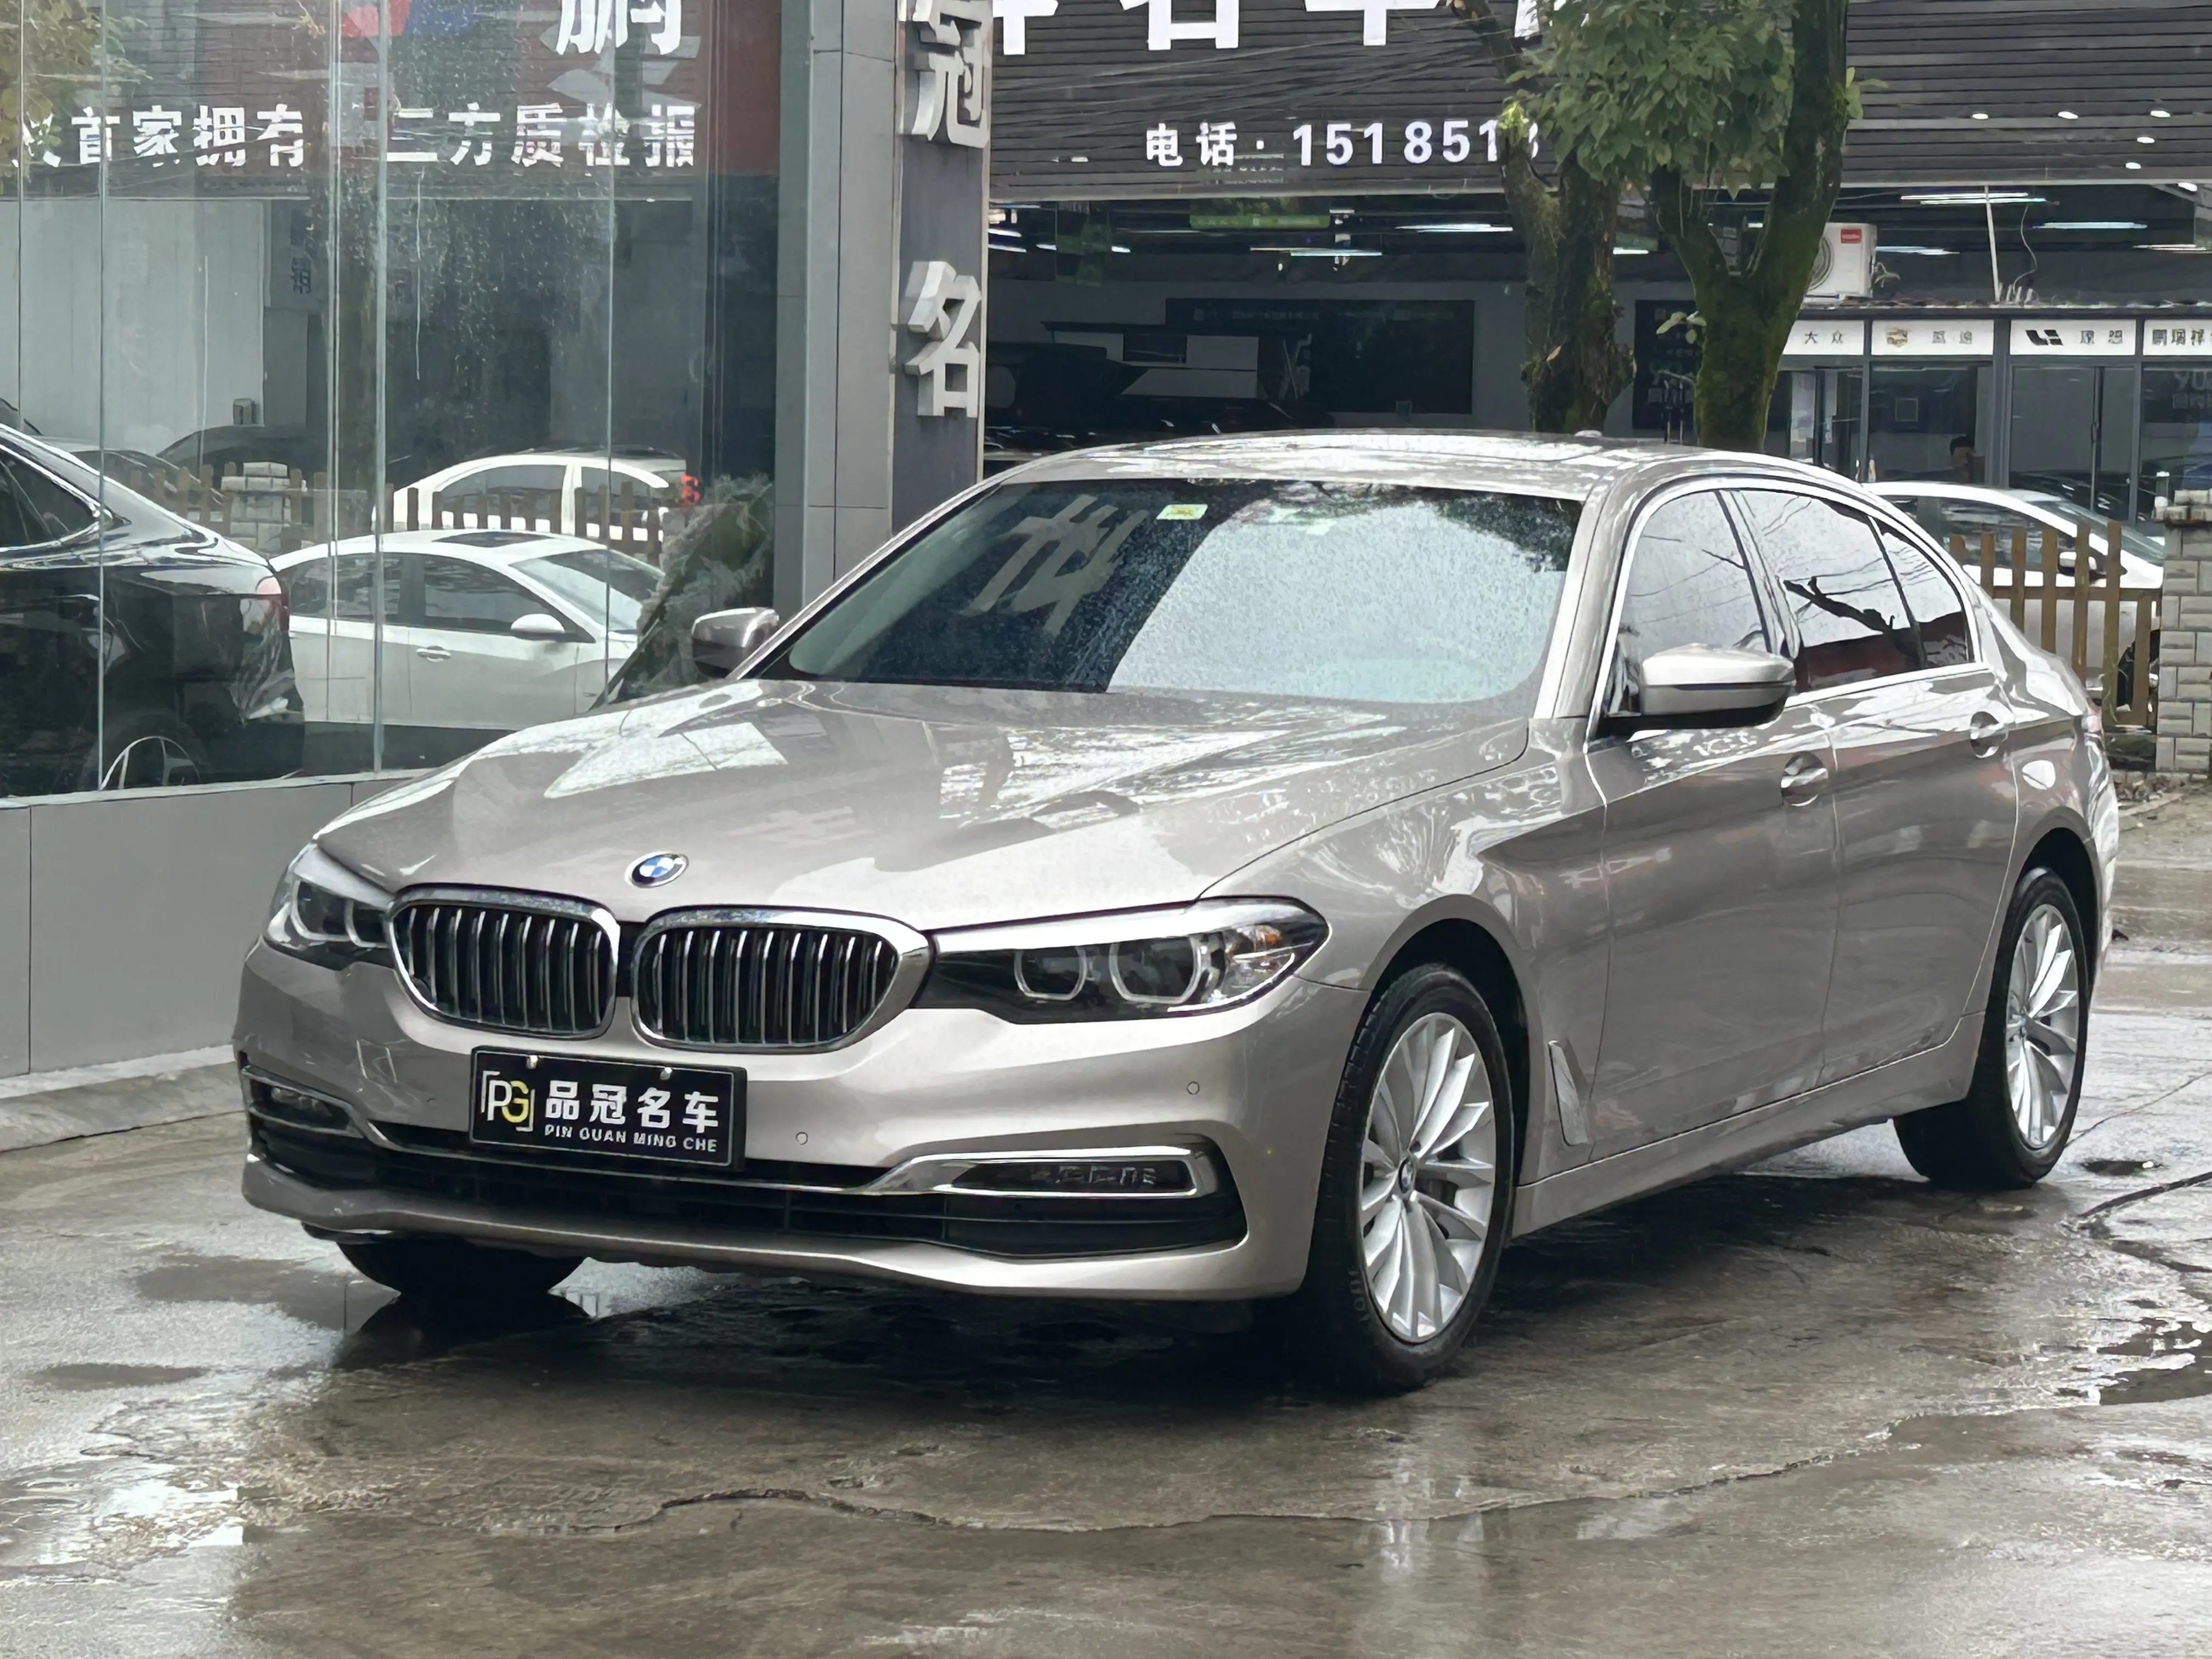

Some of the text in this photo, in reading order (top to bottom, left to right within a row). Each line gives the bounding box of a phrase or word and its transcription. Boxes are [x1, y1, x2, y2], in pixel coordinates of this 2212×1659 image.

[1293, 120, 1538, 166] 151851
[487, 1079, 529, 1124] PG
[545, 1080, 719, 1134] 品冠名车
[544, 1124, 573, 1138] PIN
[633, 1132, 677, 1148] MING
[682, 1137, 718, 1152] CHE
